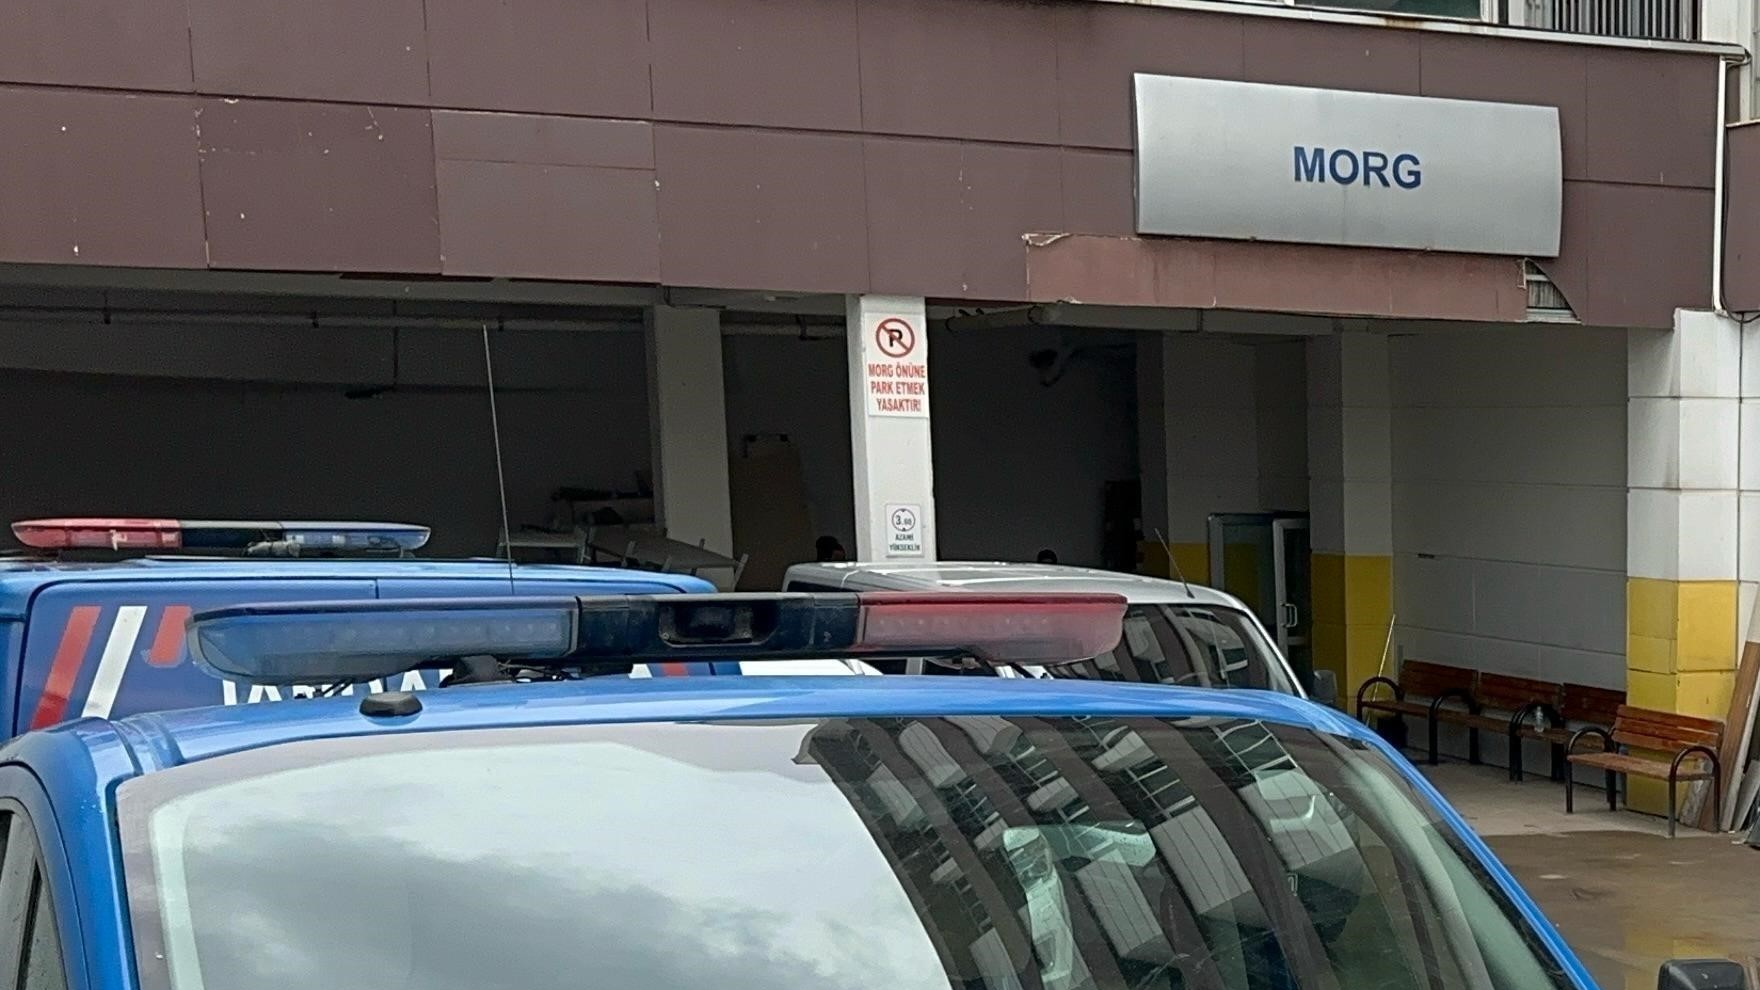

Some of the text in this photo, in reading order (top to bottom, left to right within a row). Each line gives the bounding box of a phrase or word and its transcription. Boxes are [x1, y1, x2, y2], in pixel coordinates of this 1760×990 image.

[1294, 146, 1422, 189] MORG
[868, 361, 926, 378] MORG ÖNÜNE
[871, 381, 925, 395] PARK ETMEK
